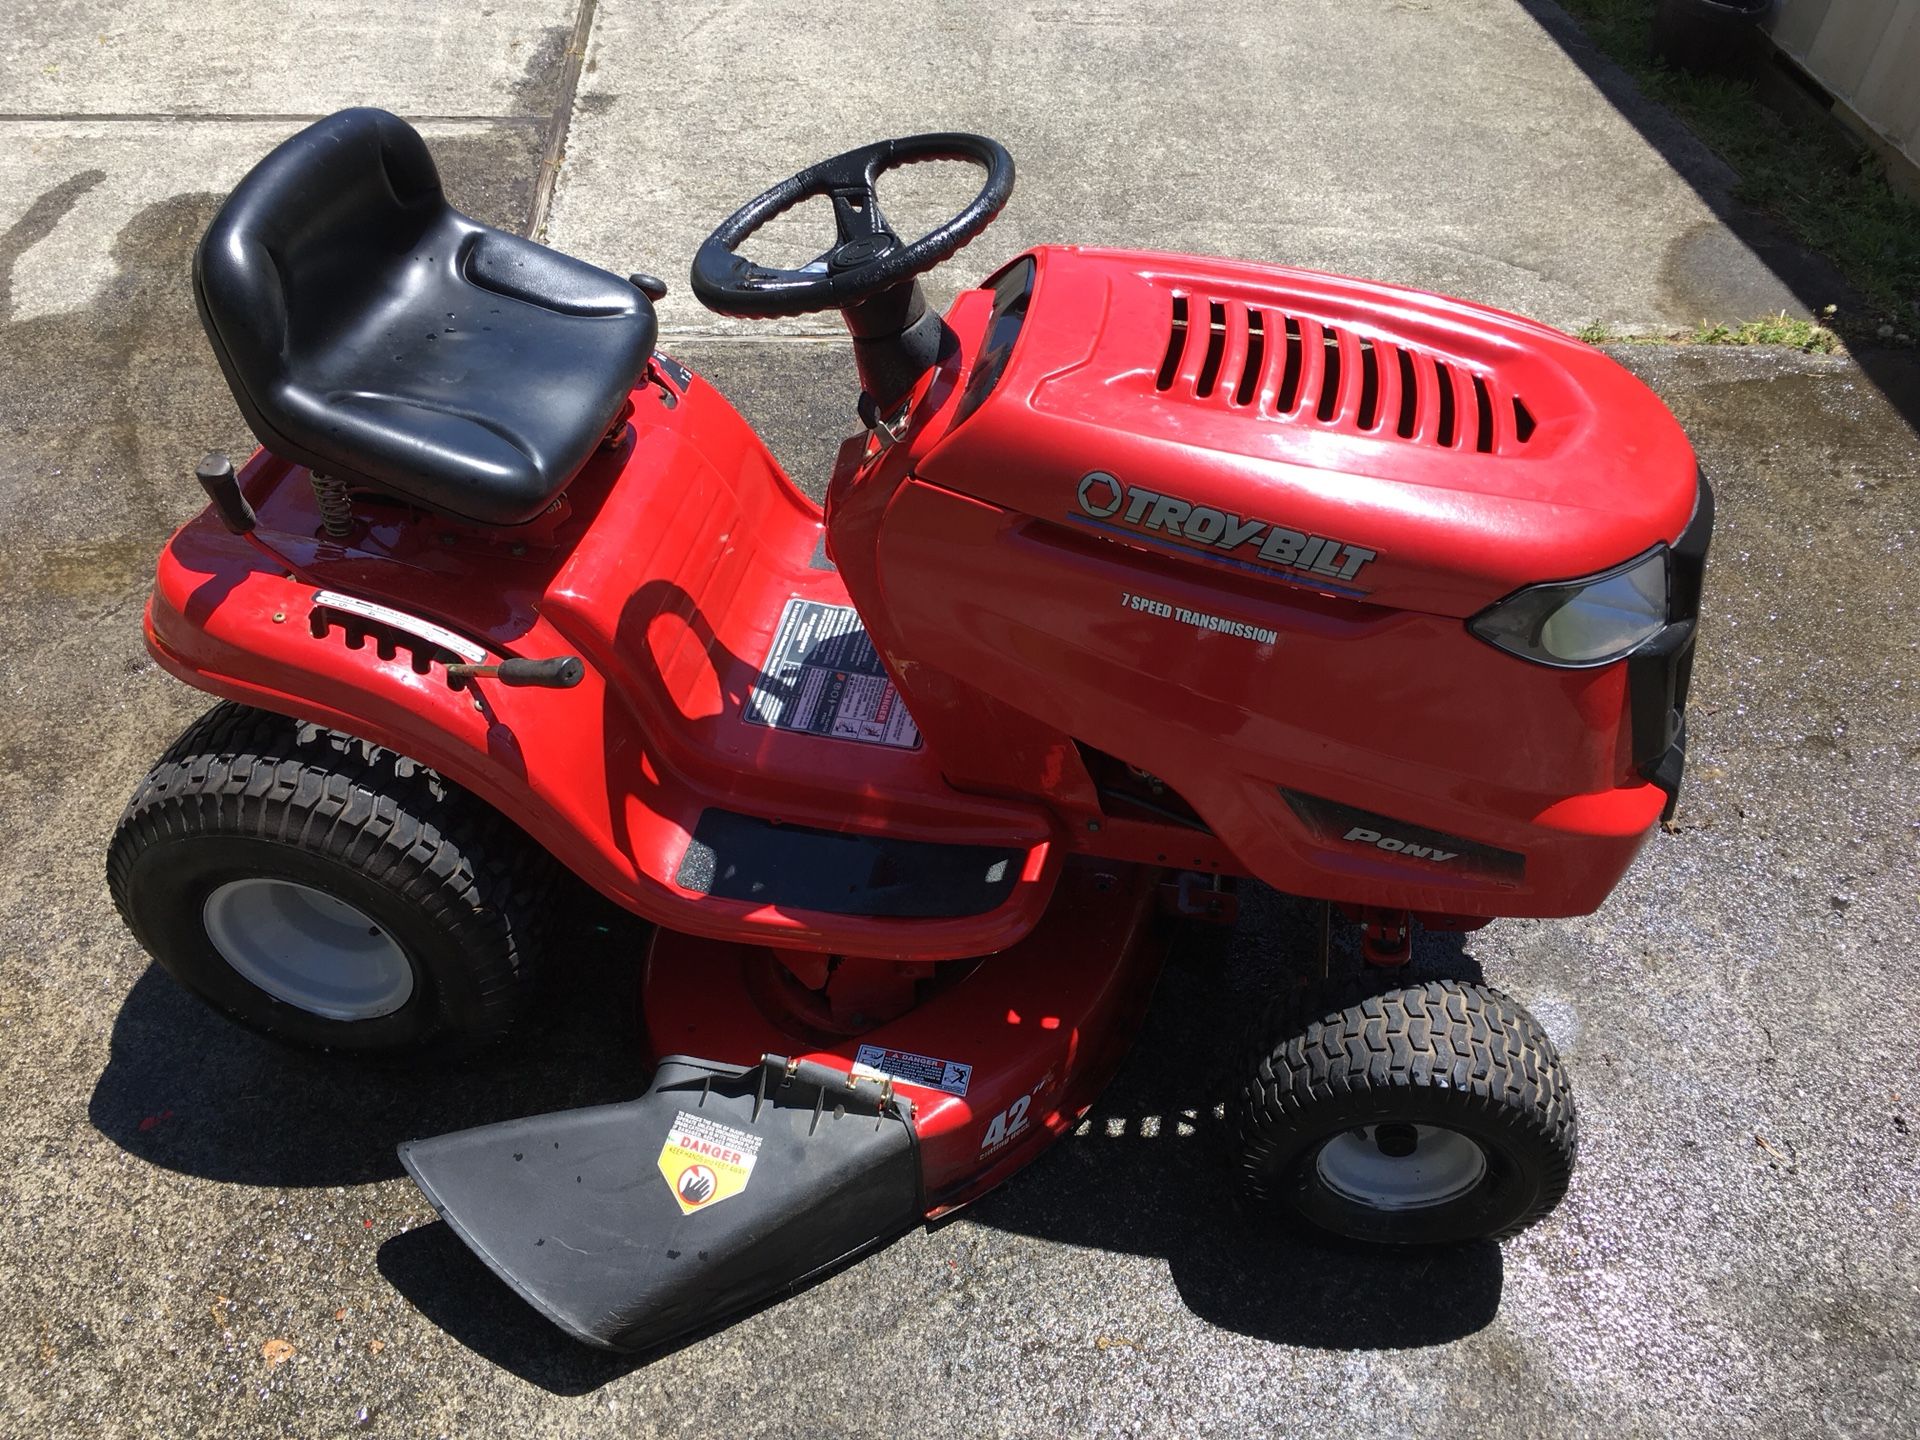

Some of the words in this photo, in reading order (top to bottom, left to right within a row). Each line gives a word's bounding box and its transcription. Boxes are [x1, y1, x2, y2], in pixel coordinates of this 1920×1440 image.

[1123, 486, 1378, 581] TROY-BILT
[1121, 592, 1130, 607] 7
[1131, 595, 1172, 619] SPEED
[1174, 607, 1278, 645] TRANSMISSION
[876, 689, 895, 721] DANGER
[1343, 827, 1459, 862] PONY
[902, 1055, 938, 1066] DANGER
[680, 1136, 742, 1164] DANGER
